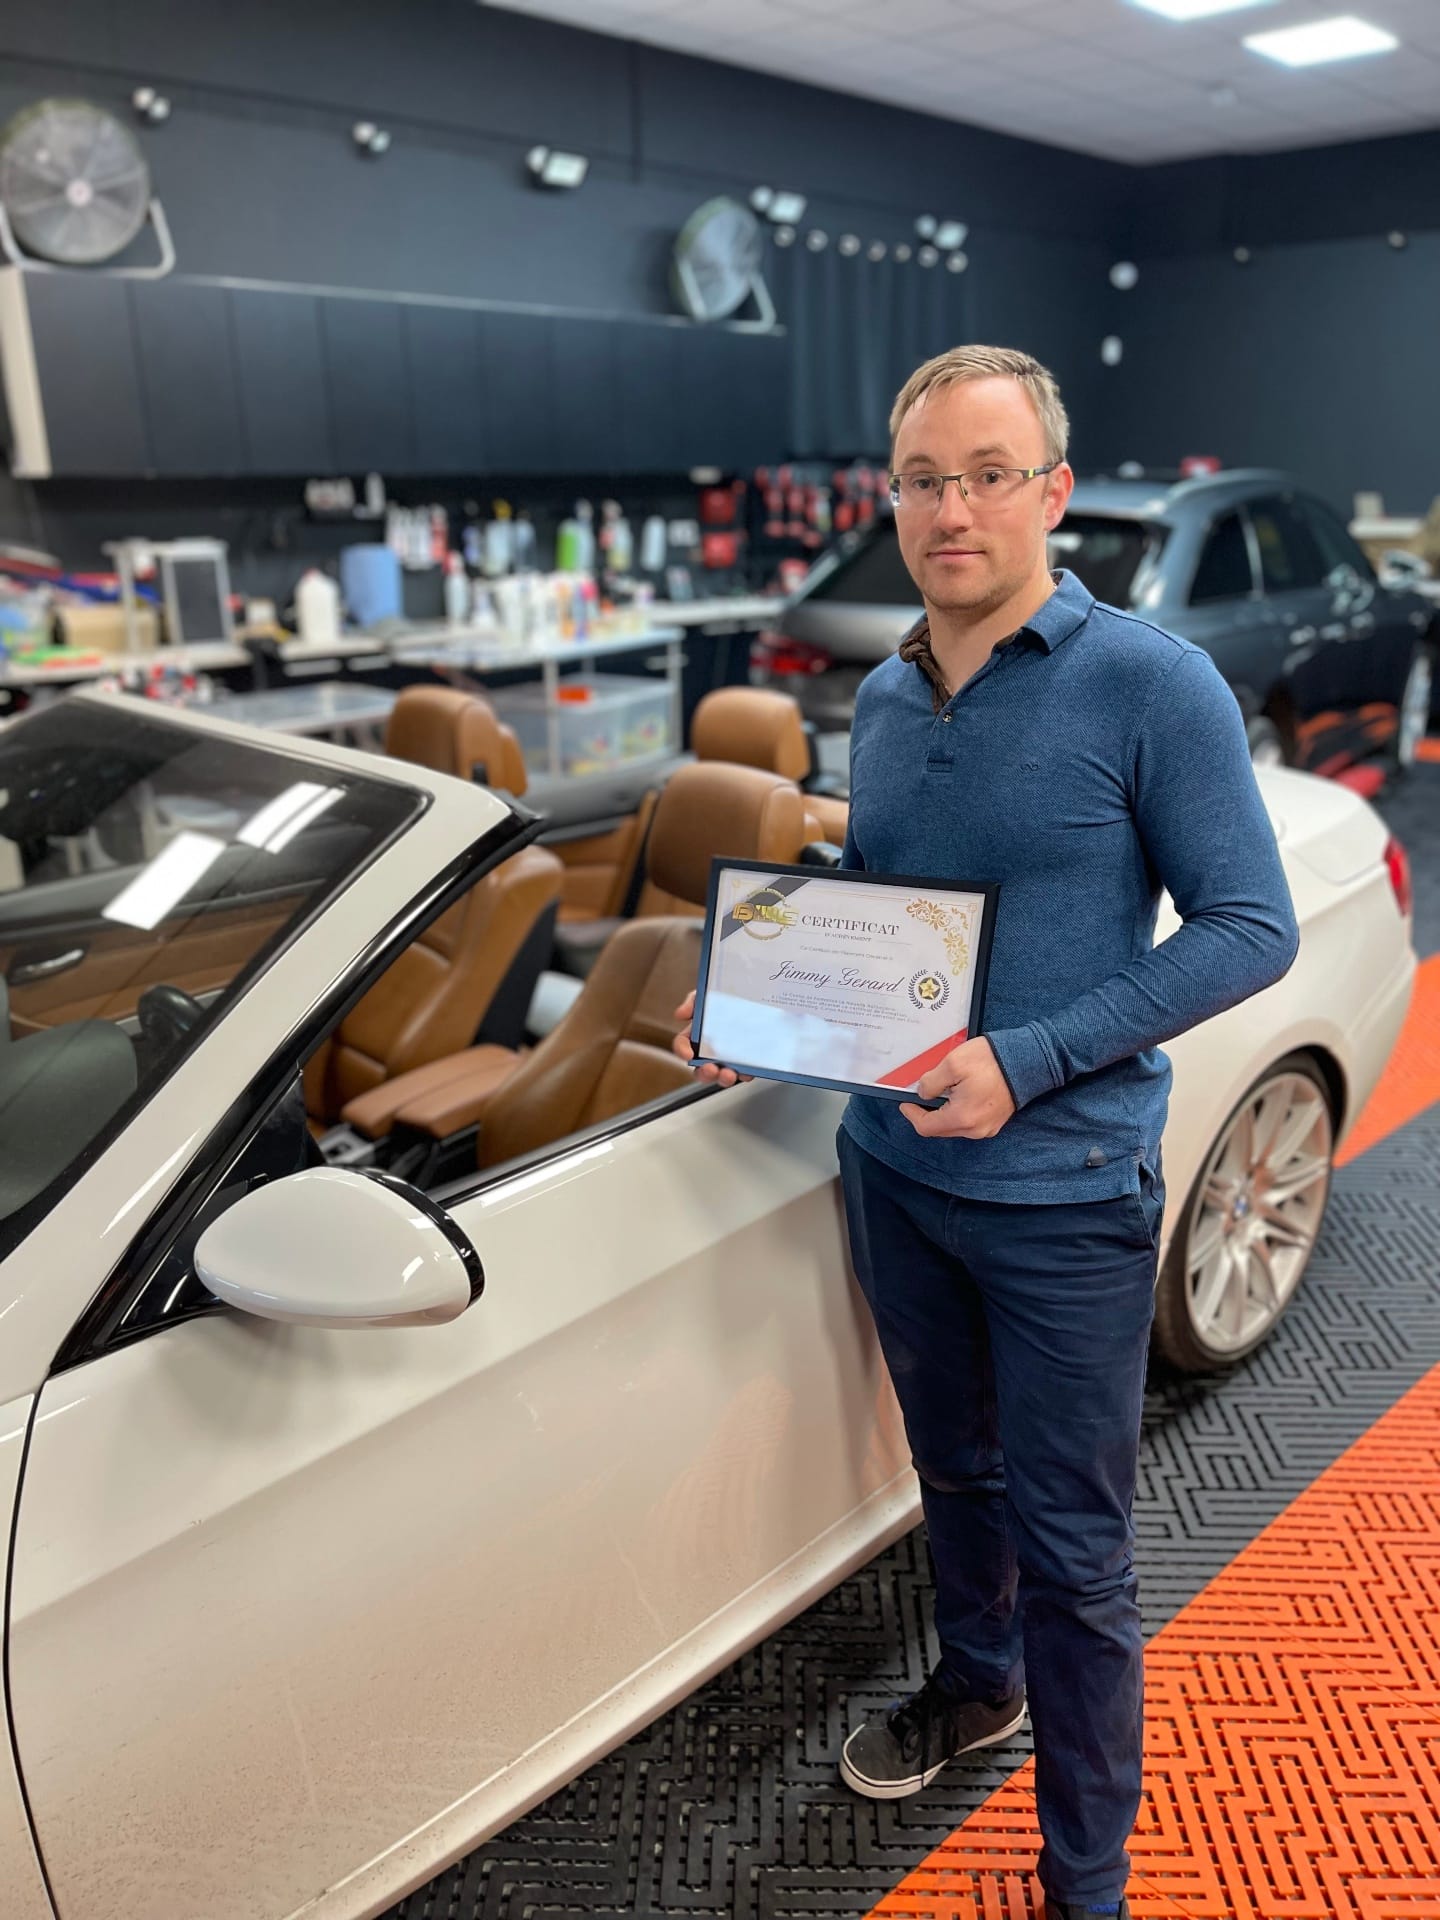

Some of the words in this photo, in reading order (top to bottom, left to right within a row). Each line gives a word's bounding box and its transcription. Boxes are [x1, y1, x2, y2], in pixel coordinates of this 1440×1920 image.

[801, 914, 900, 936] CERTIFICAT
[769, 960, 831, 989] Jimmy
[837, 967, 905, 993] Gerard
